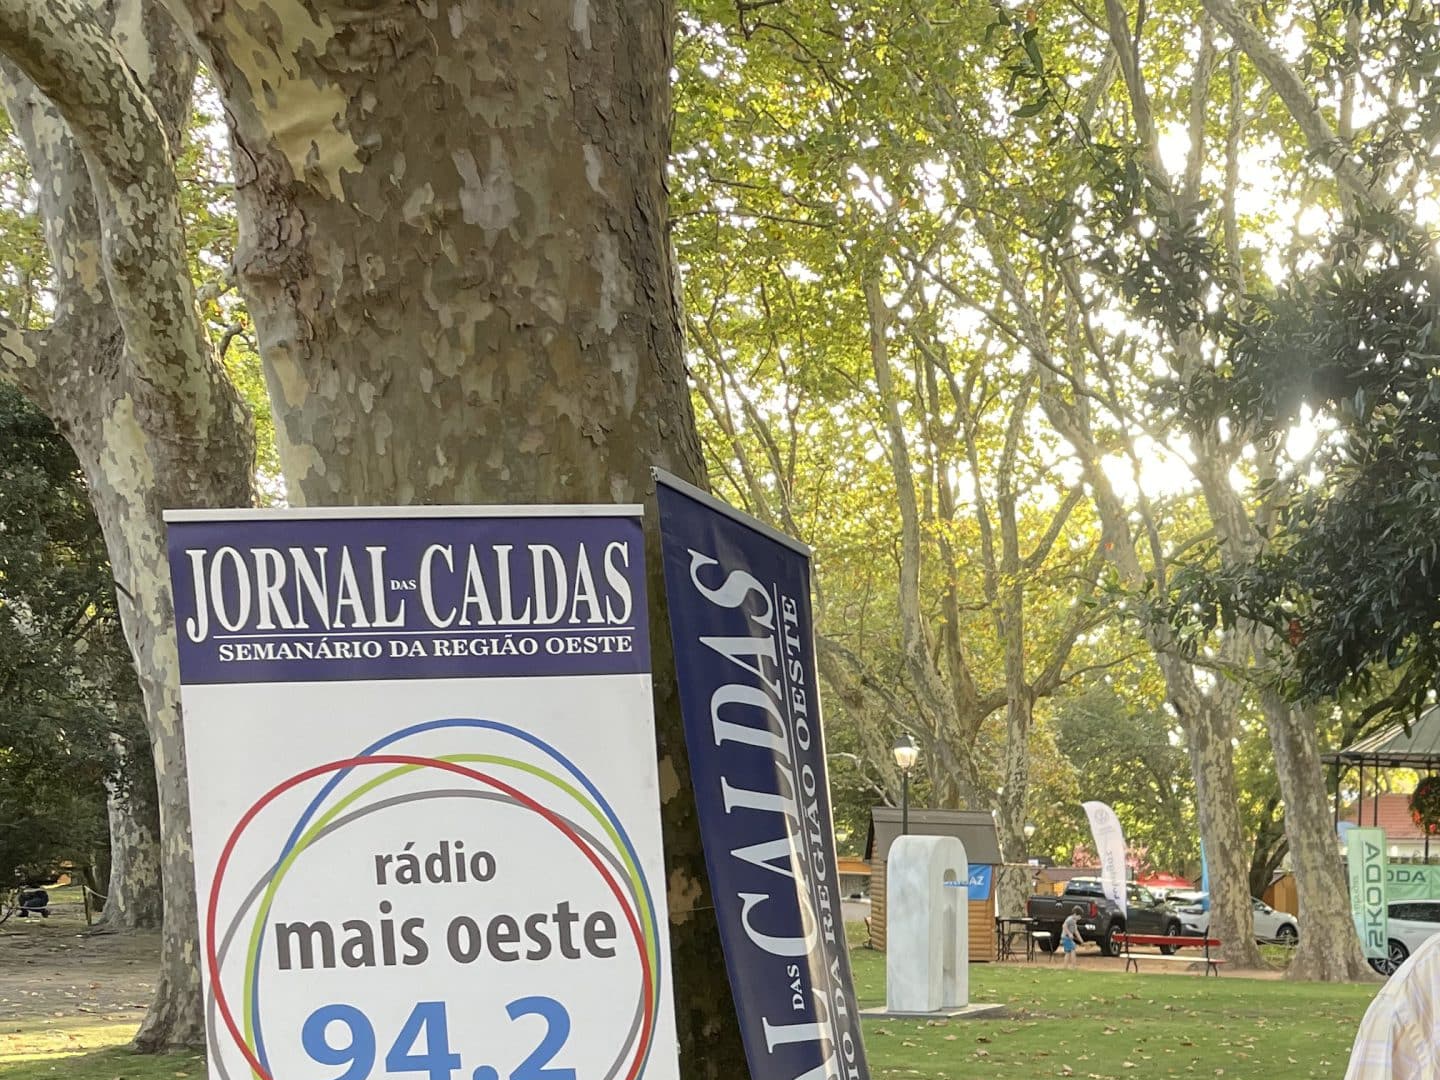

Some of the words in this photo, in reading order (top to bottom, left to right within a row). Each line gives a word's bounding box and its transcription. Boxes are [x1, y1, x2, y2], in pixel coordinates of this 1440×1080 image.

[185, 546, 404, 643] JORNAL
[390, 579, 417, 591] DAS
[420, 541, 632, 628] CALDAS
[219, 637, 382, 661] SEMANÁRIO
[389, 640, 427, 657] DA
[433, 634, 538, 656] REGIÃO
[546, 636, 633, 654] OESTE
[782, 595, 811, 749] OESTE
[687, 548, 819, 957] CALDAS
[374, 841, 497, 885] rádio
[801, 768, 836, 945] REGIÃO
[275, 900, 429, 970] mais
[447, 900, 617, 964] oeste
[787, 964, 805, 1010] DAS
[830, 956, 848, 1018] DA
